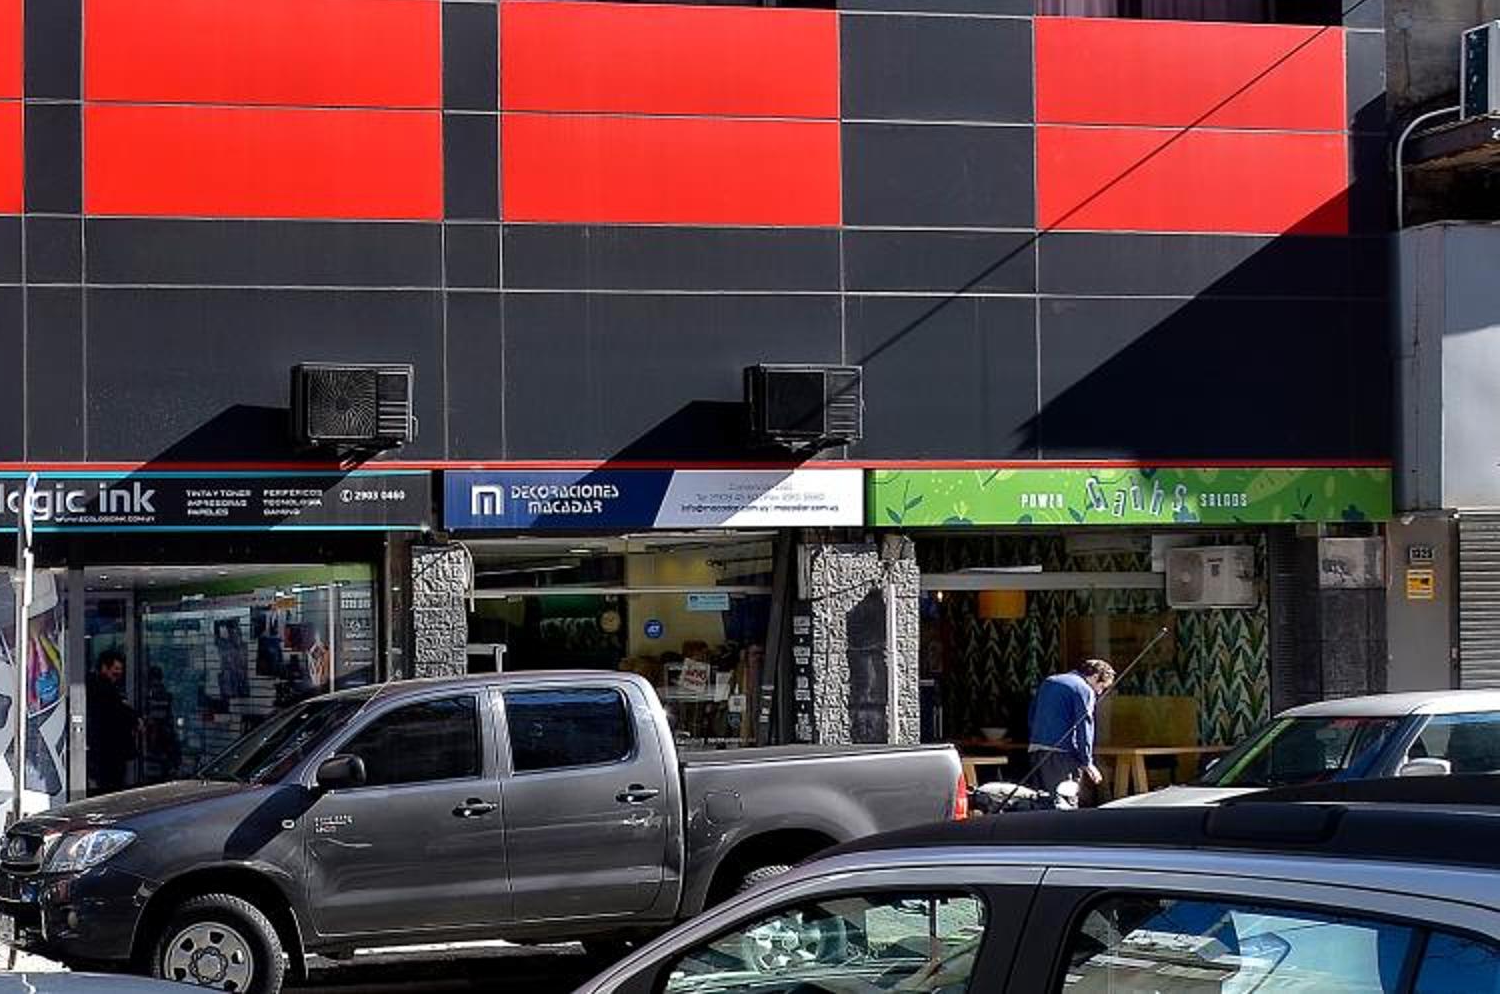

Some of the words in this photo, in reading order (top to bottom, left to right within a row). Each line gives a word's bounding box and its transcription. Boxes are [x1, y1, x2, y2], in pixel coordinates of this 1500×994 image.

[100, 481, 156, 512] ink
[1021, 493, 1064, 509] POWER
[1200, 493, 1248, 508] SALADS
[527, 501, 603, 514] MACADAR
